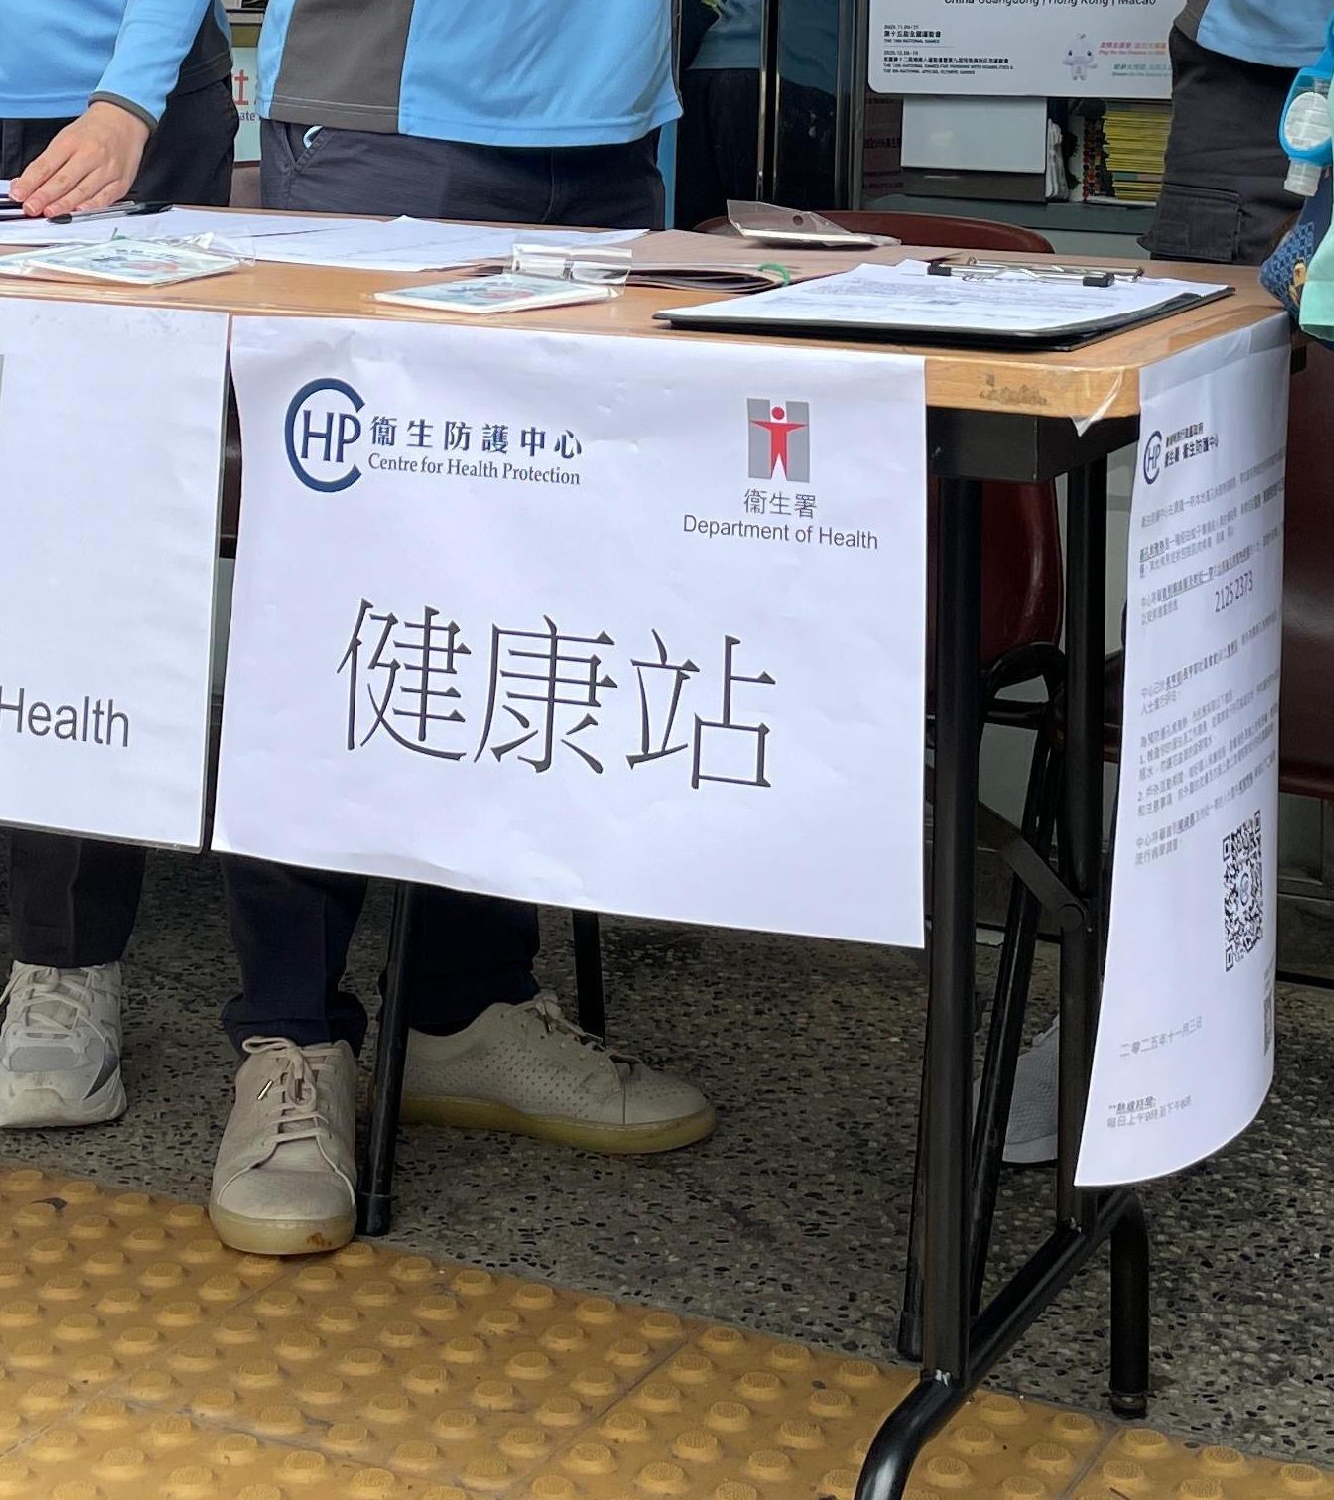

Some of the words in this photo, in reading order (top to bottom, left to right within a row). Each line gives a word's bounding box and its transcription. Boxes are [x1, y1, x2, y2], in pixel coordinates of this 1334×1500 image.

[284, 377, 366, 493] CHP
[1143, 429, 1163, 485] CHP
[367, 451, 417, 473] Centre
[419, 454, 445, 475] for
[446, 456, 499, 480] Health
[502, 461, 582, 487] Protection
[683, 513, 790, 543] Department
[795, 523, 813, 545] of
[818, 525, 880, 551] Health
[1215, 582, 1234, 613] 2125
[1234, 569, 1253, 600] 2373
[336, 597, 777, 790] 健康站
